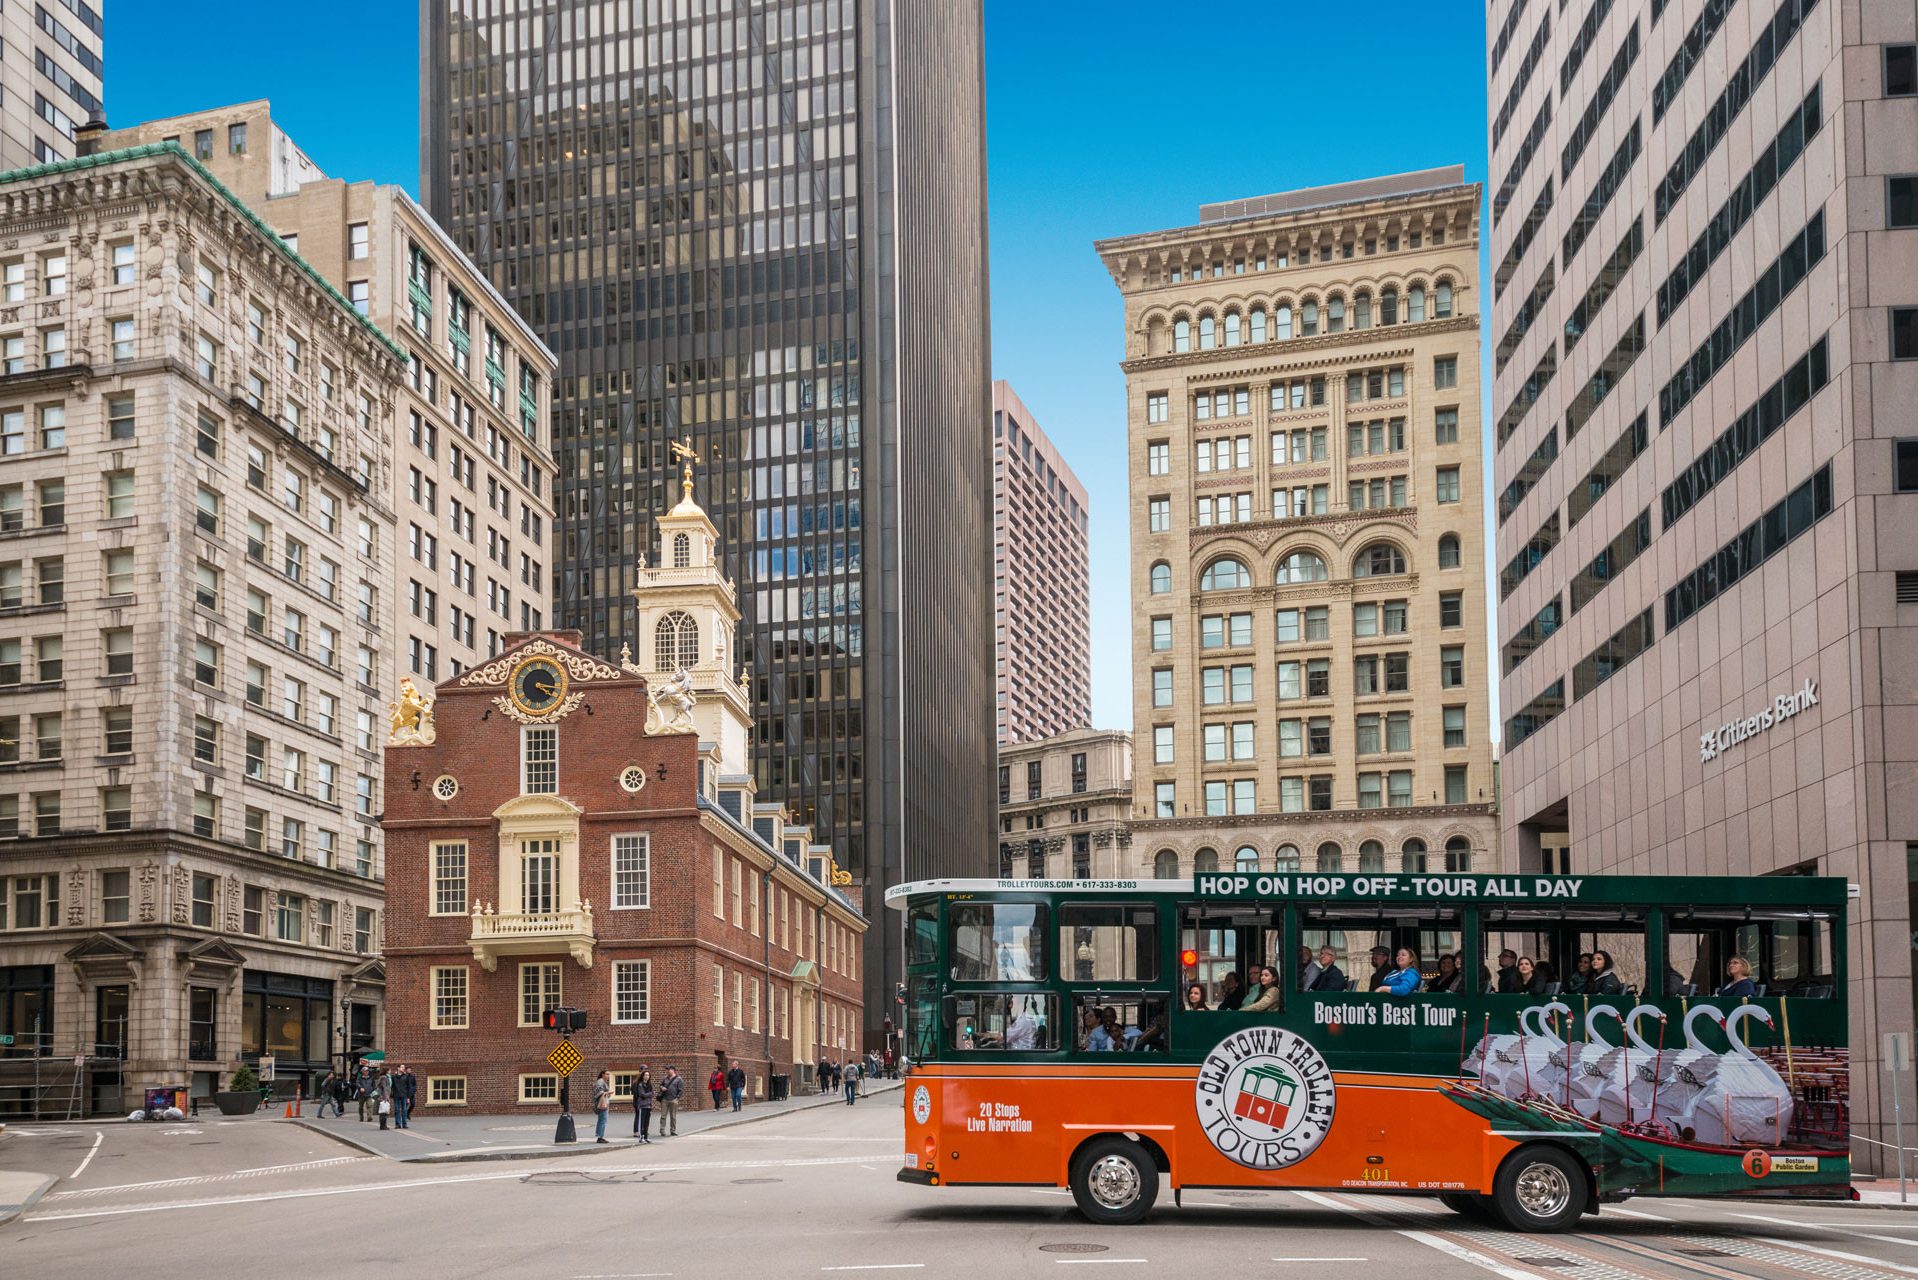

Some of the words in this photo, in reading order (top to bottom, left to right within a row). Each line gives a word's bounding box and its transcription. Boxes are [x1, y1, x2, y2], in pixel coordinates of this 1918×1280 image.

[1717, 707, 1774, 752] Citizens
[1775, 678, 1819, 723] Bank
[997, 880, 1073, 889] TROLLEYTOURS.COM
[1082, 881, 1137, 889] 617-333-8303
[1200, 877, 1249, 895] HOP
[1255, 877, 1289, 895] ON
[1296, 877, 1346, 895] HOP
[1483, 879, 1528, 897] ALL
[1535, 879, 1583, 897] DAY
[1314, 1001, 1377, 1024] Boston's
[1383, 1002, 1416, 1025] Best
[1422, 1003, 1456, 1026] Tour
[1199, 1055, 1230, 1095] OLD
[1222, 1029, 1283, 1062] TOWN
[1286, 1037, 1333, 1132] TROLLEY
[980, 1102, 992, 1117] 20
[995, 1102, 1020, 1119] Stops
[967, 1117, 986, 1132] Live
[988, 1117, 1032, 1133] Narration
[1205, 1109, 1302, 1167] TOURS
[1361, 1168, 1390, 1181] 401
[1751, 1158, 1763, 1175] 6
